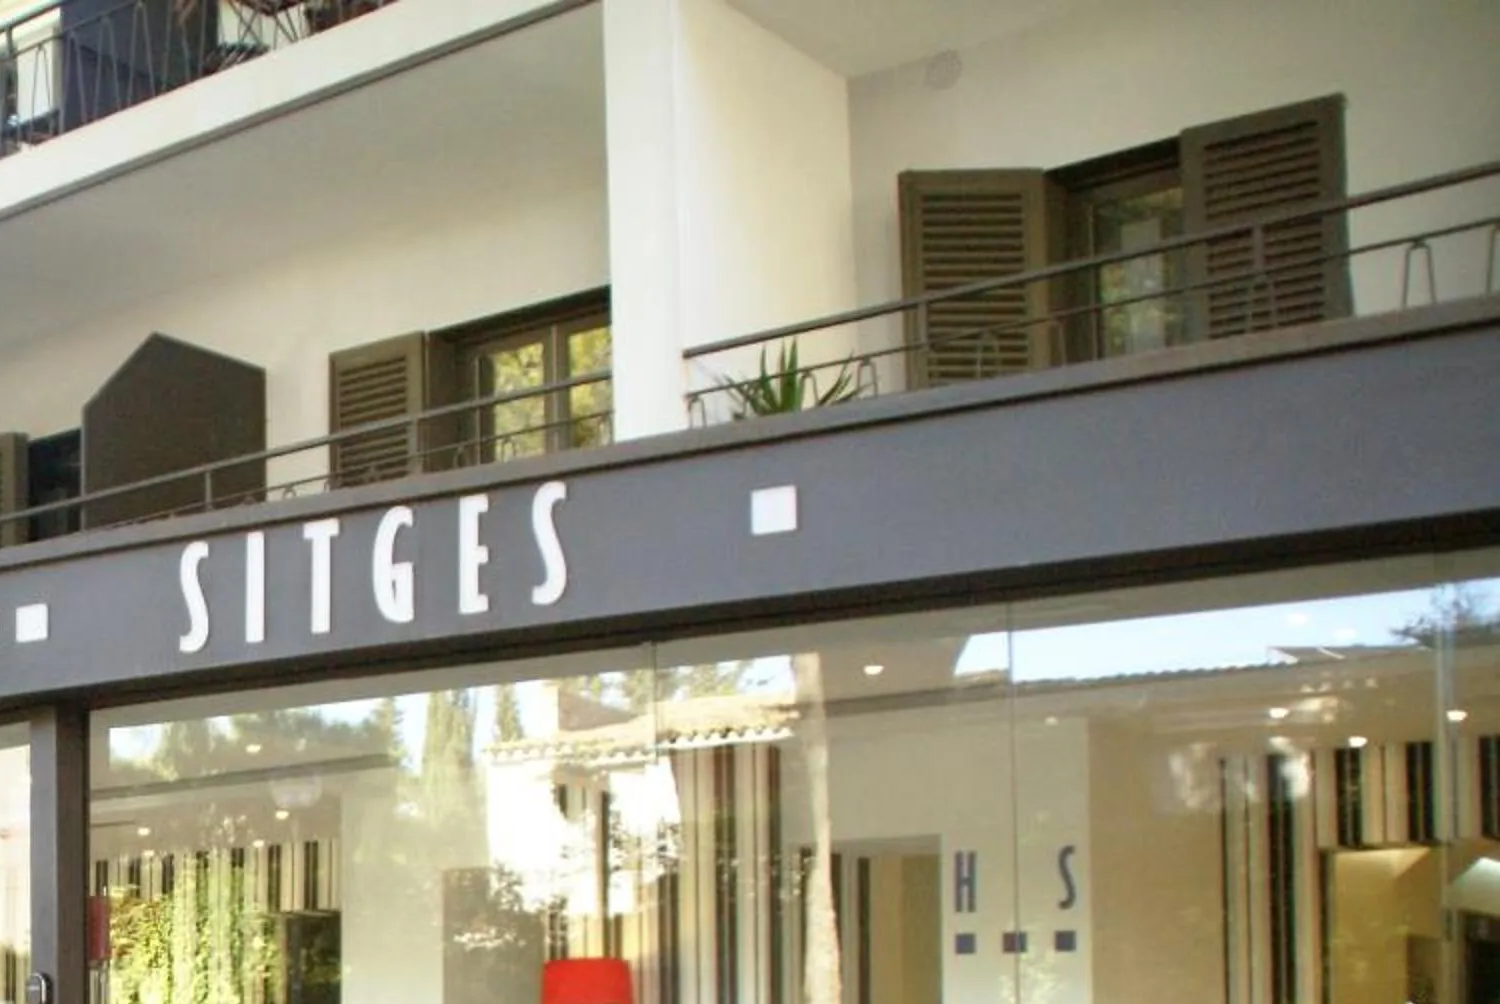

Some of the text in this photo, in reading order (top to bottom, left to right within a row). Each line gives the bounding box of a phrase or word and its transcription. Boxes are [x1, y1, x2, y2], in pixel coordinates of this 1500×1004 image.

[179, 480, 569, 655] SITGES
[955, 845, 1077, 913] H S
